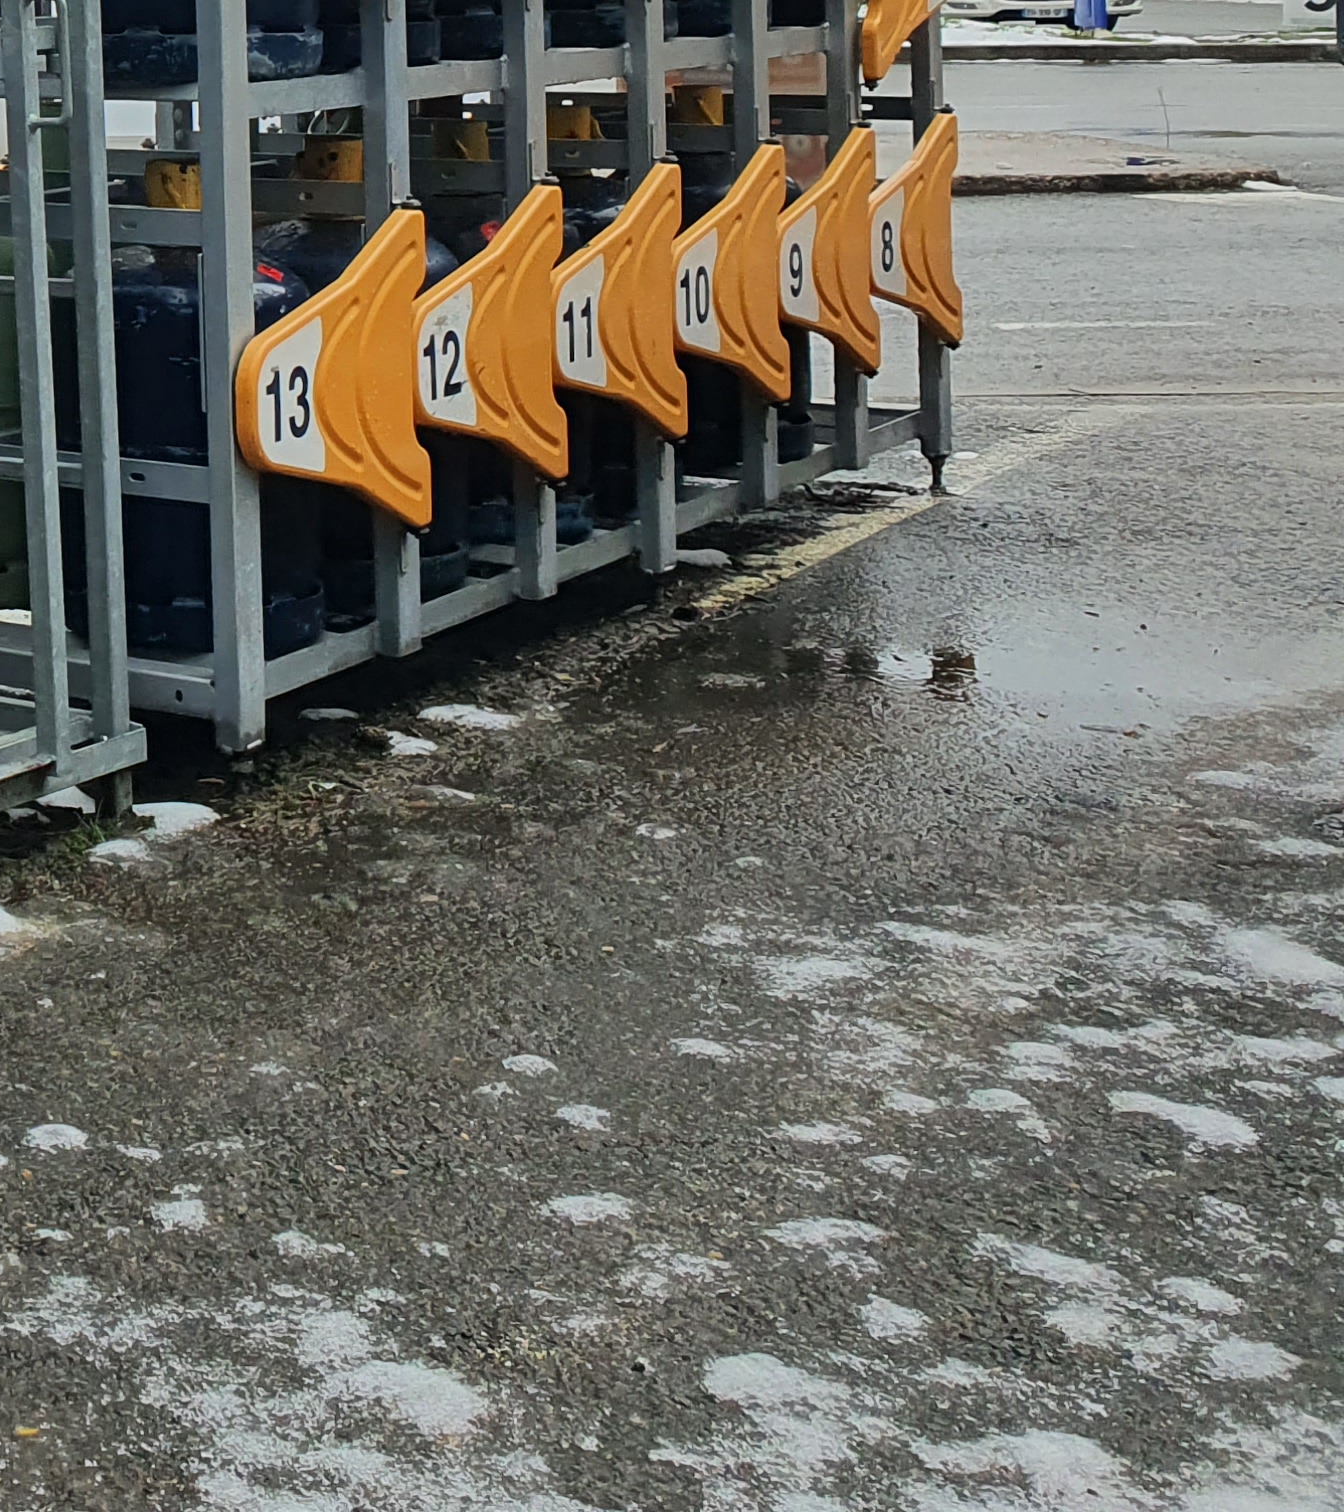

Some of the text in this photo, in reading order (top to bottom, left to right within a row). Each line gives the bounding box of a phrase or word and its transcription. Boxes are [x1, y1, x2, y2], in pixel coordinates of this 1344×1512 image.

[789, 243, 804, 298] 9
[881, 220, 894, 273] 8
[680, 265, 710, 326] 10
[563, 295, 593, 363] 11
[423, 329, 462, 400] 12
[265, 365, 310, 443] 13
